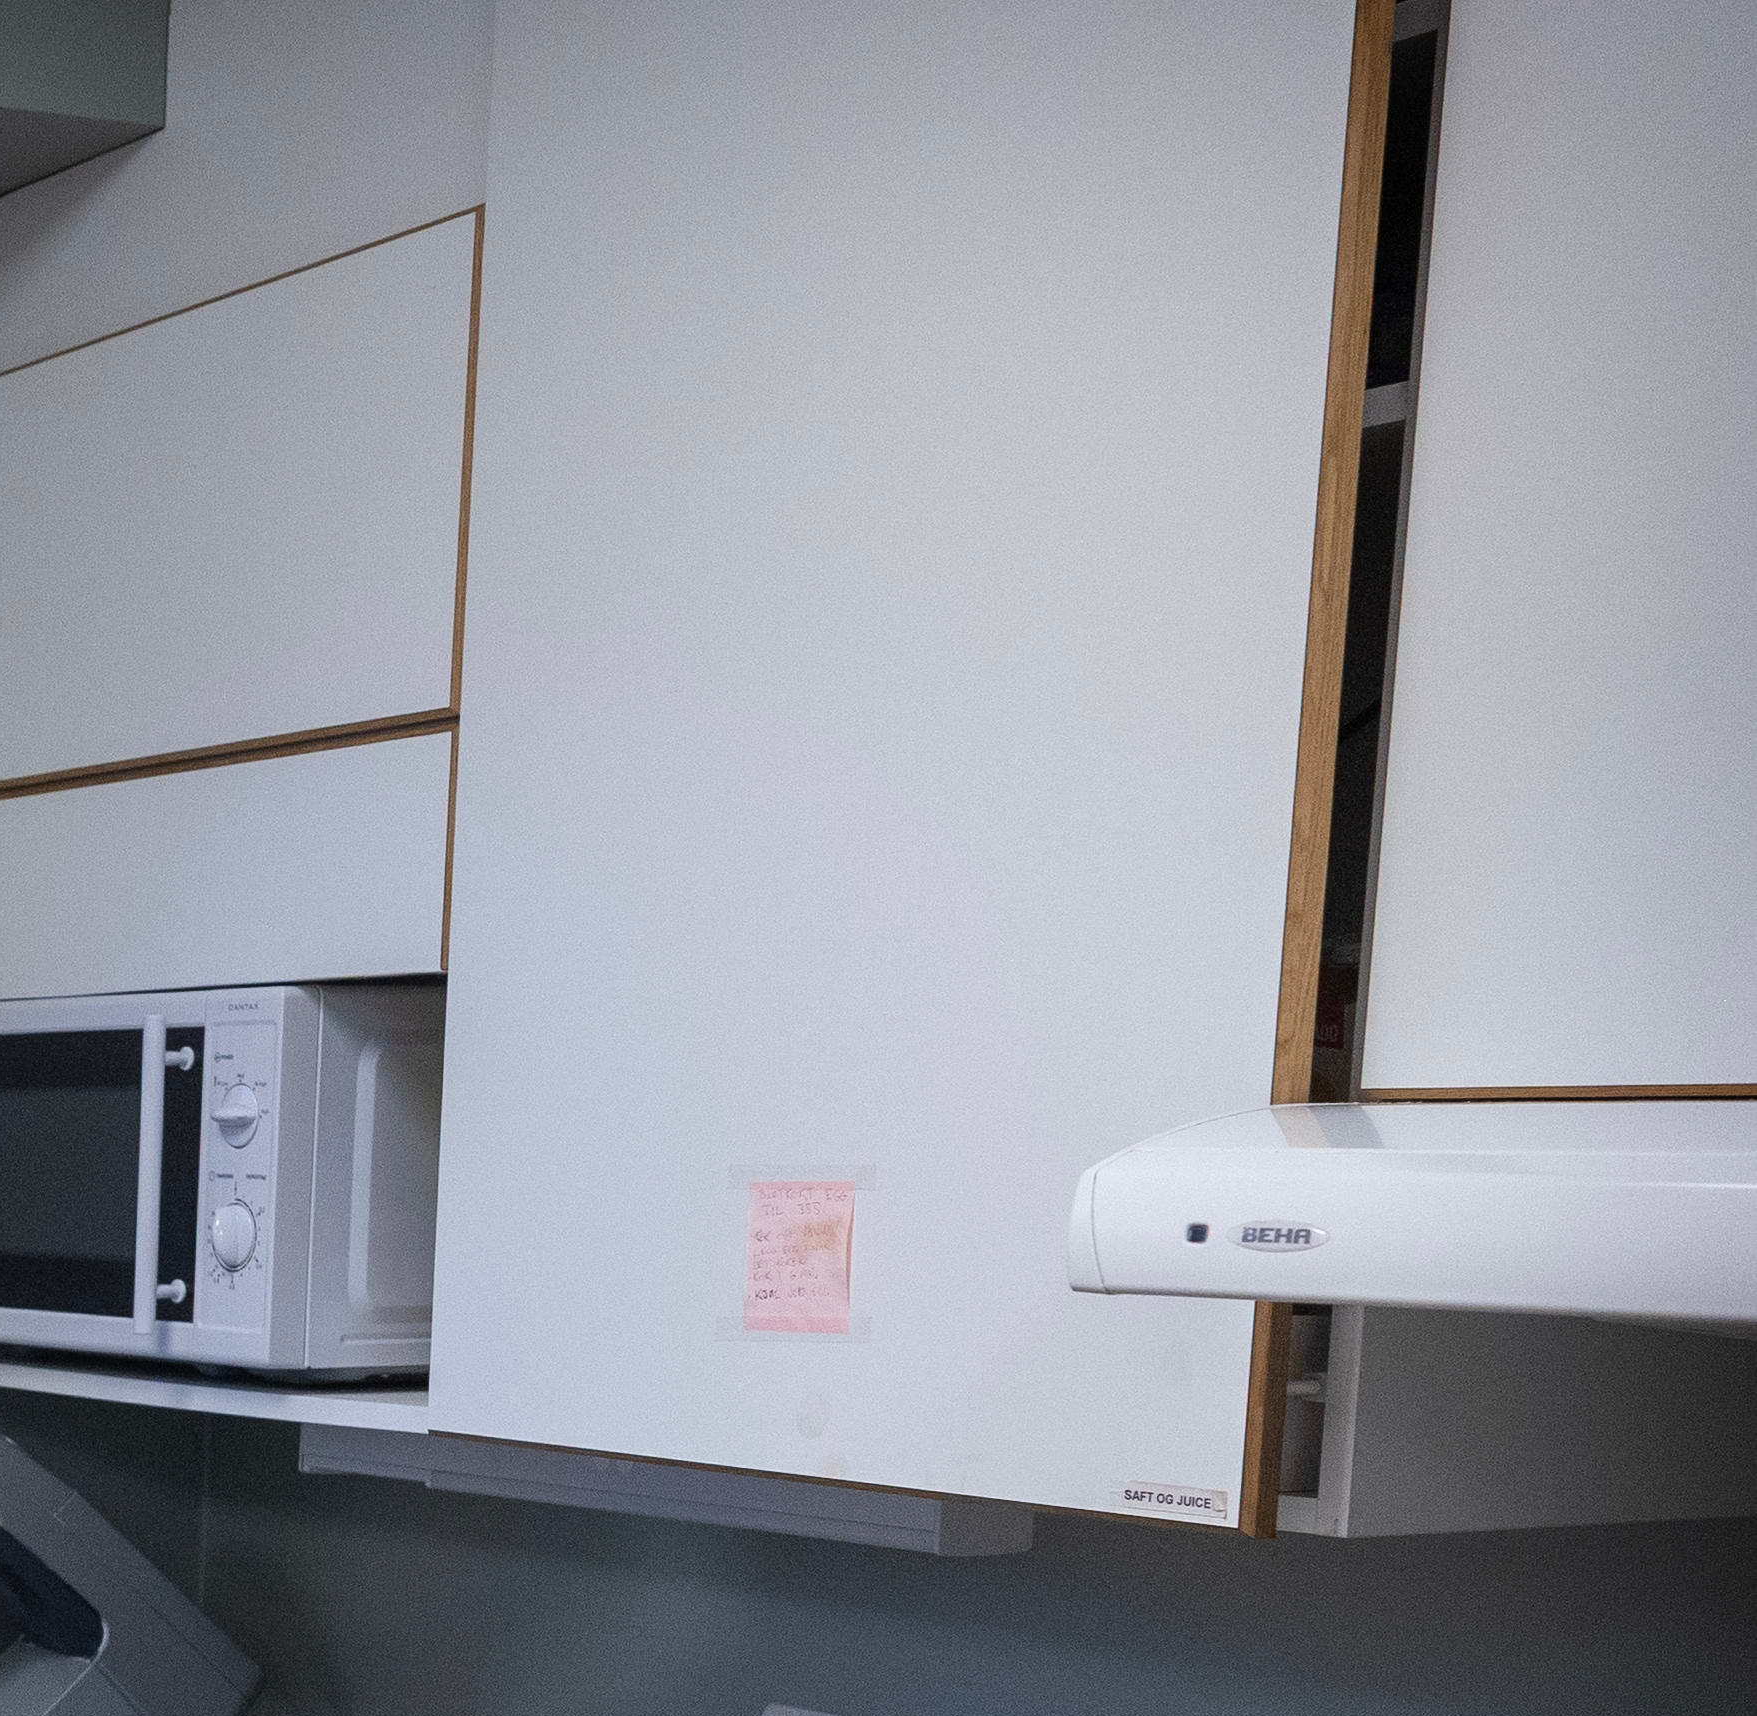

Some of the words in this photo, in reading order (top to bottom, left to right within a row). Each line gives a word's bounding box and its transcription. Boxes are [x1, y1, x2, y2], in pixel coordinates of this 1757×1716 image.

[1242, 1227, 1311, 1244] BEHA
[1124, 1489, 1154, 1502] SAFT
[1156, 1493, 1174, 1505] OG
[1176, 1495, 1211, 1509] JUICE
